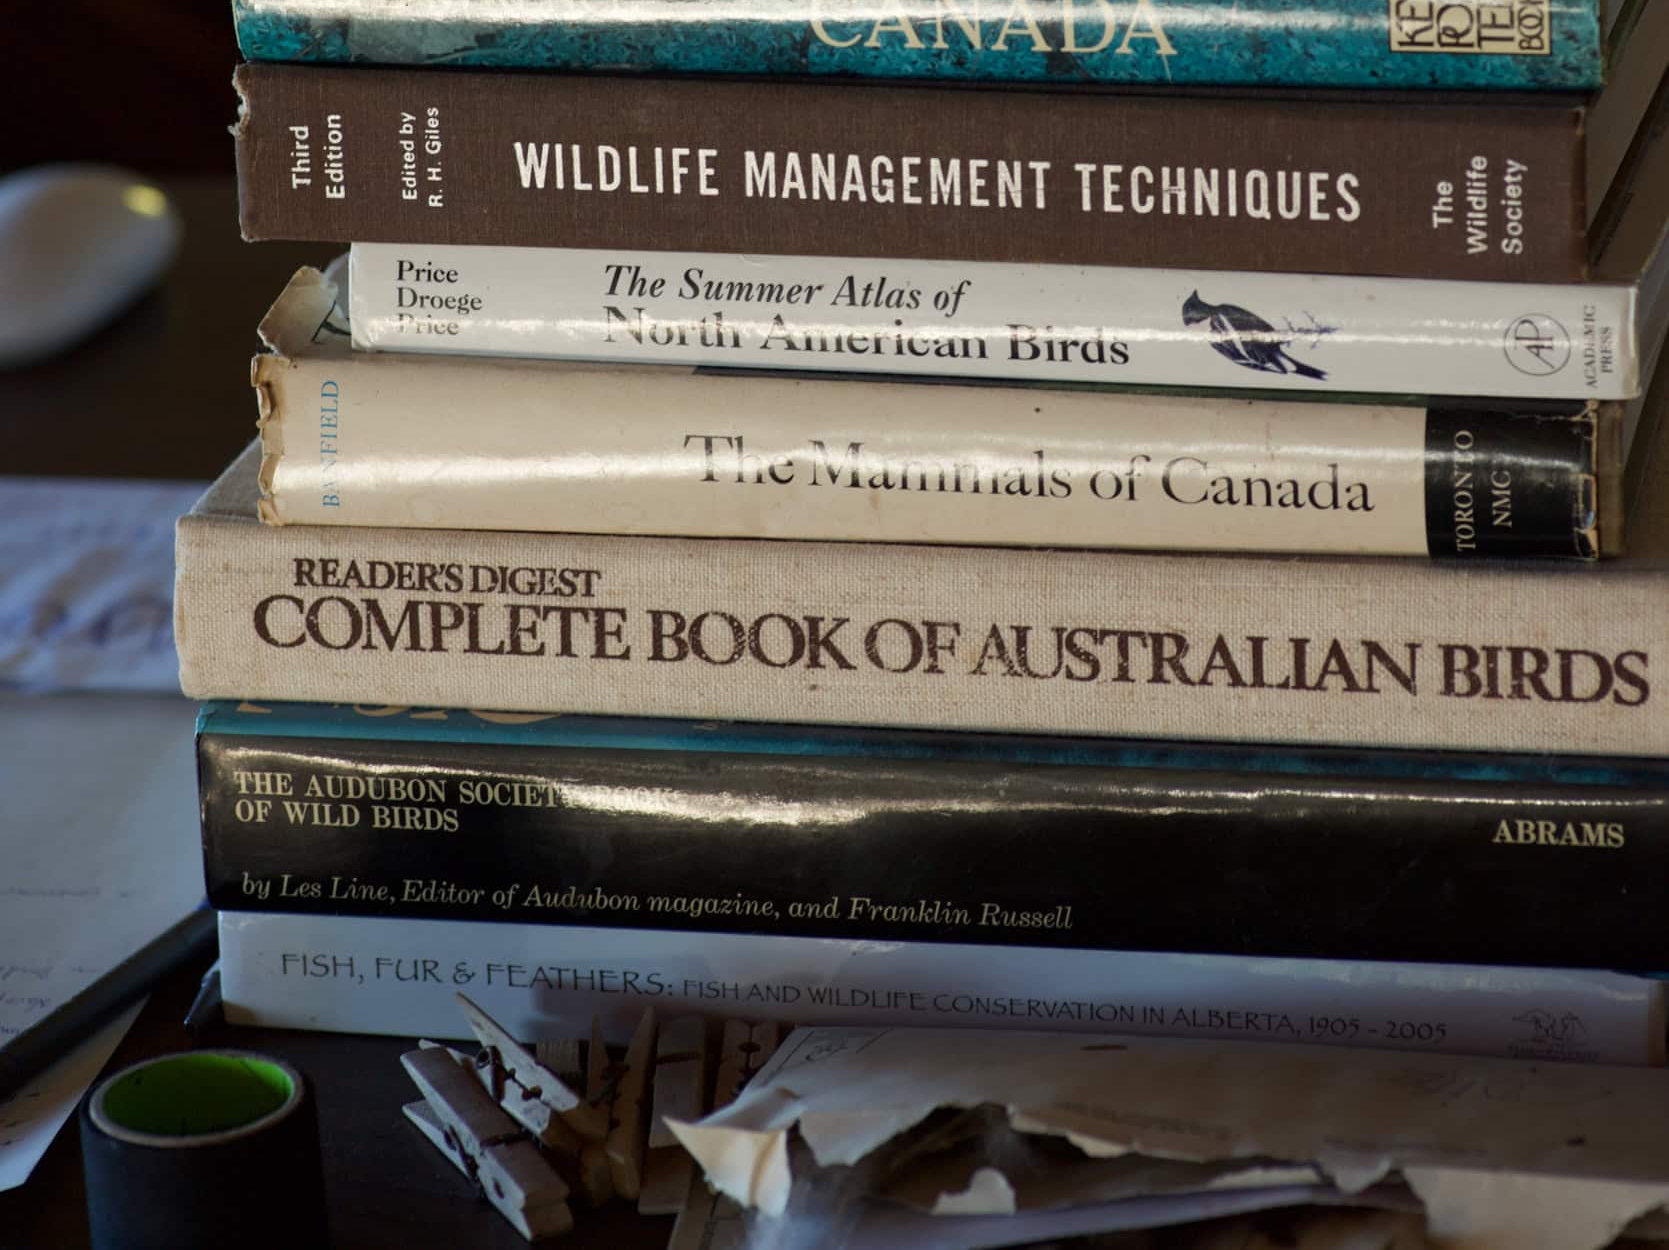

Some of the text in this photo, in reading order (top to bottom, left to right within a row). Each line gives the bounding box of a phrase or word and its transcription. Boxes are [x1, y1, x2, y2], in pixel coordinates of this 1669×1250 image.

[289, 125, 311, 189] Third
[324, 113, 346, 200] Edition
[399, 112, 418, 201] Edited by
[425, 107, 442, 155] Giles
[514, 142, 1362, 222] WILDLIFE MANAGEMENT TECHNIQUES
[1433, 180, 1453, 228] The
[1467, 155, 1489, 255] Wildlife
[1501, 159, 1529, 255] Society
[397, 260, 458, 283] Price
[397, 287, 482, 315] Droege
[605, 264, 972, 317] The Summer Atlas of
[398, 313, 459, 336] Price
[604, 306, 1130, 366] North American Birds
[1584, 304, 1598, 389] ACADEMIC
[1600, 326, 1614, 374] PRESS
[684, 434, 1375, 513] The Mammals of Canada
[1454, 429, 1477, 552] TORONTO
[1491, 470, 1513, 528] NMC
[293, 558, 602, 599] READER'S DIGEST
[252, 594, 1653, 708] COMPLETE BOOK OF AUSTRALIAN BIRDS
[234, 771, 293, 797] THE
[304, 774, 447, 804] AUDUBON
[234, 800, 460, 833] OF WILD BIRDS
[1493, 818, 1626, 848] ABRAMS
[242, 872, 1074, 931] by Les Line, Editor of Audubon magazine, and Franklin Russell
[281, 954, 365, 982] FISH,
[376, 958, 443, 985] FUR
[452, 961, 476, 986] &
[487, 963, 675, 997] FEATHERS:
[683, 979, 740, 1002] FISH
[747, 982, 800, 1005] AND
[807, 985, 928, 1012] WILDLIFE
[933, 991, 1136, 1025] CONSERVATION
[1141, 1005, 1165, 1026] IN
[1173, 1007, 1301, 1037] ALBERTA,
[1308, 1017, 1360, 1039] 1905
[1386, 1021, 1447, 1043] 2005
